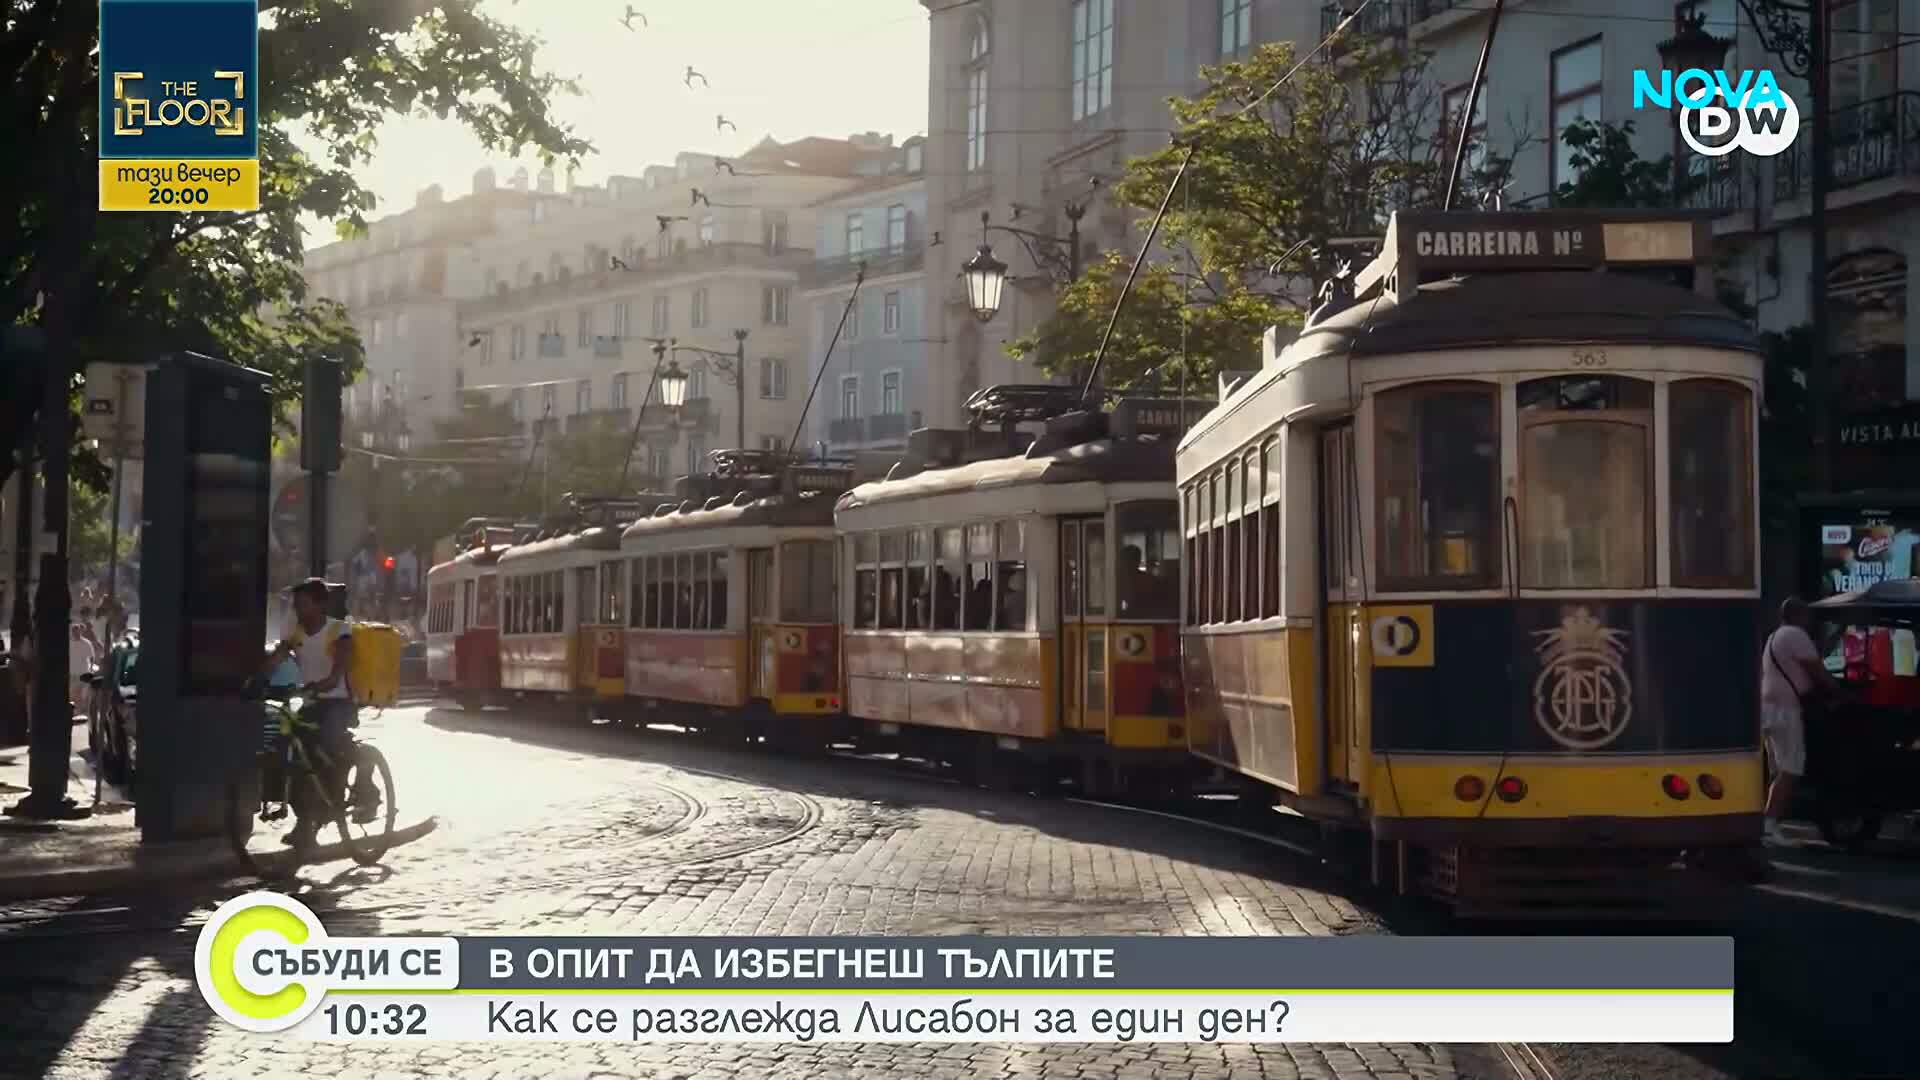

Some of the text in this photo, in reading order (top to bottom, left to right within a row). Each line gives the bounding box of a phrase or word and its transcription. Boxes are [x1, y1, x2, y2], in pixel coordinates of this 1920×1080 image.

[1416, 230, 1539, 257] CARREIRA
[1572, 351, 1607, 367] 563
[1840, 424, 1894, 443] VISTA
